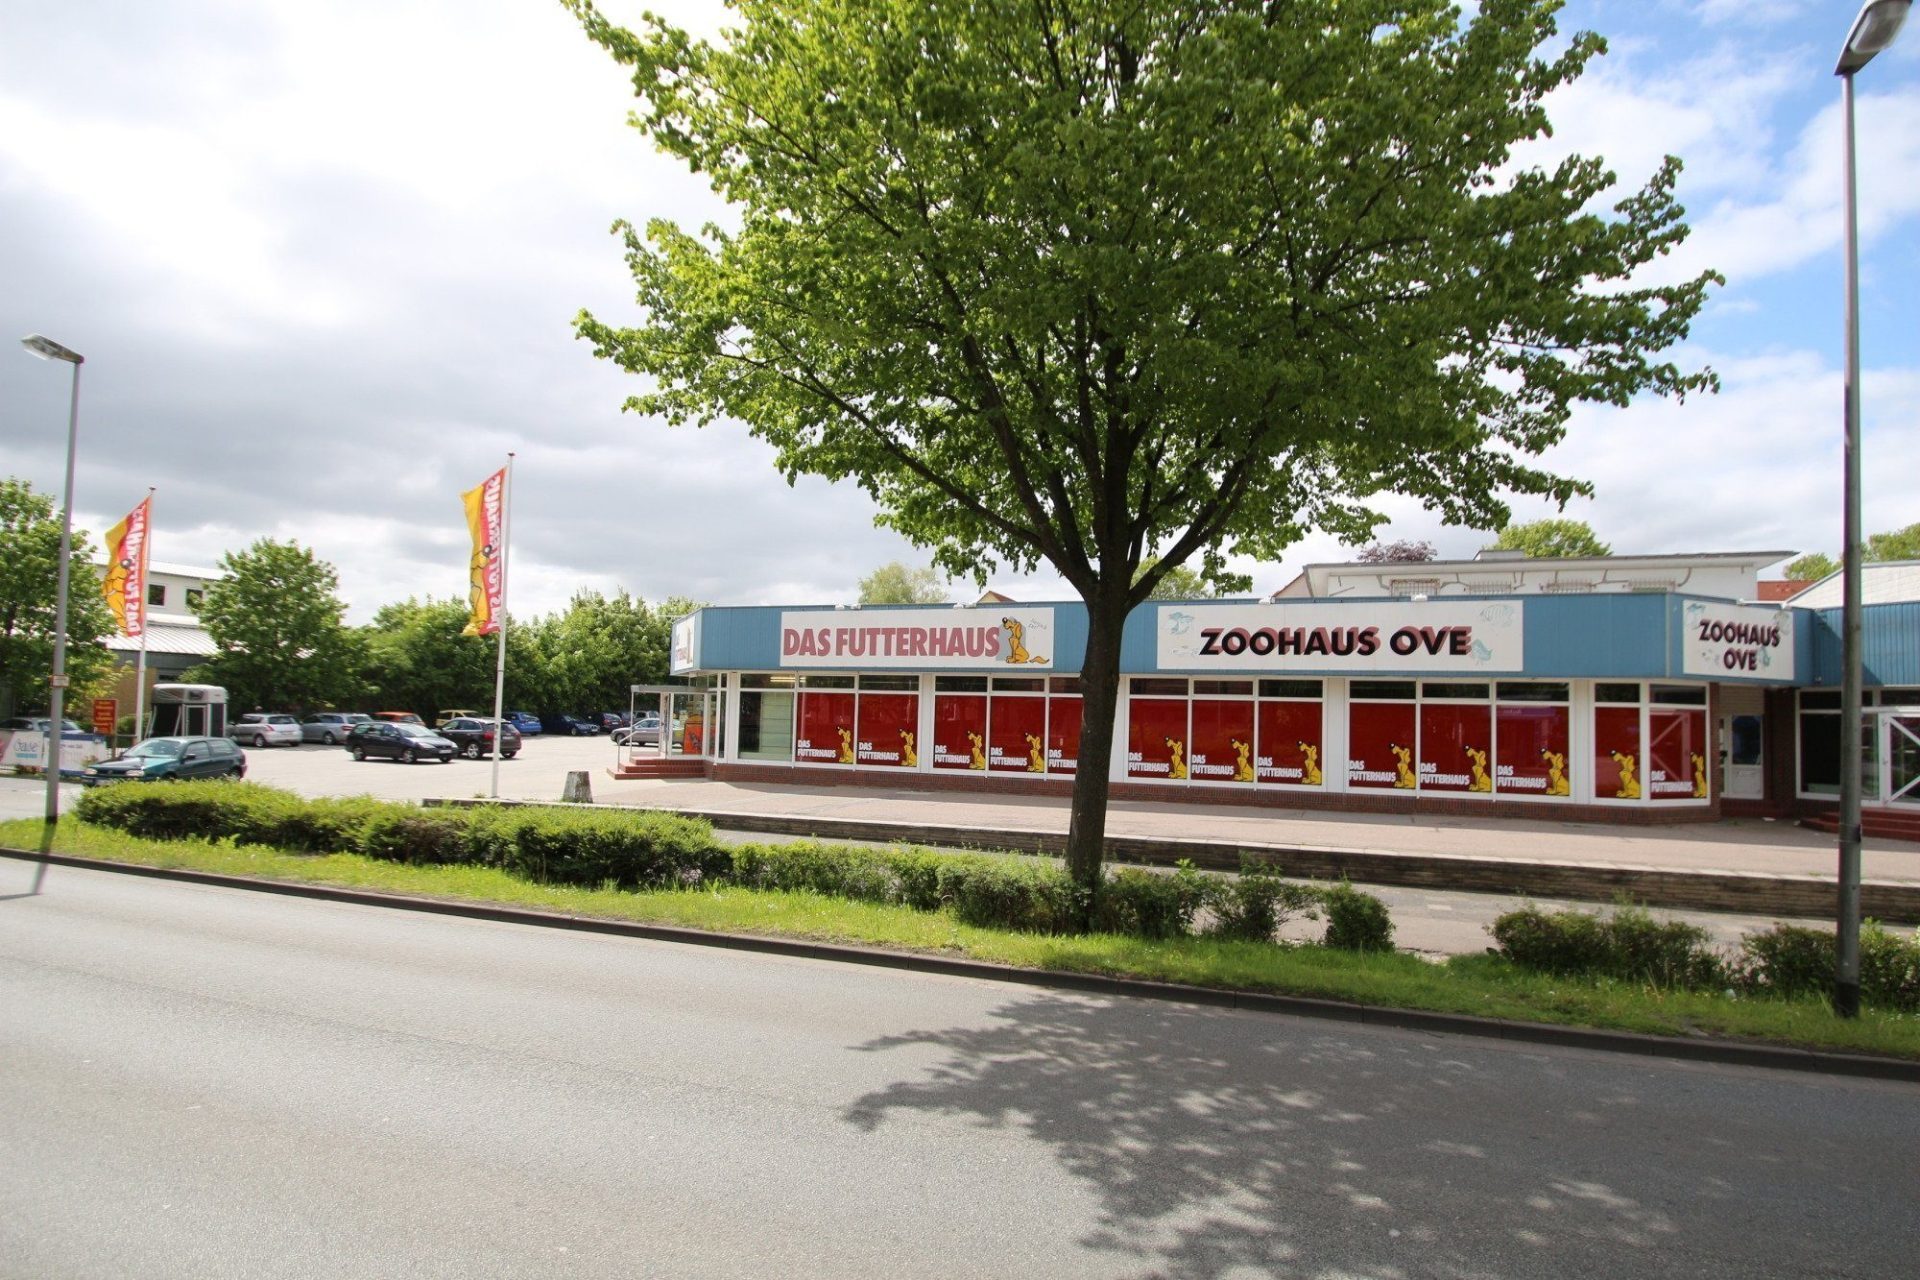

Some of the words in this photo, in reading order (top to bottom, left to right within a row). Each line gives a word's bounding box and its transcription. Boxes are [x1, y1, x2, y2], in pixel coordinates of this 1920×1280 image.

[1699, 618, 1780, 648] ZOOHAUS
[783, 628, 831, 657] DAS
[835, 626, 1000, 658] FUTTERHAUS
[1199, 626, 1381, 656] ZOOHAUS
[1389, 625, 1473, 656] OVE
[1723, 647, 1758, 671] OVE
[797, 740, 811, 748] DAS
[858, 742, 872, 751] DAS
[797, 748, 836, 758] FUTTERHAUS
[934, 745, 947, 754] DAS
[990, 747, 1003, 756] DAS
[1049, 749, 1062, 758] DAS
[858, 751, 899, 760] FUTTERHAUS
[934, 754, 970, 764] FUTTERHAUS
[1128, 752, 1142, 761] DAS
[1191, 755, 1206, 764] DAS
[990, 756, 1027, 766] FUTTERHAUS
[1258, 757, 1272, 766] DAS
[1349, 760, 1364, 770] DAS
[1128, 762, 1170, 772] FUTTERHAUS
[1191, 764, 1234, 775] FUTTERHAUS
[1420, 763, 1436, 773] DAS
[1497, 765, 1513, 776] DAS
[1258, 767, 1303, 778] FUTTERHAUS
[1349, 770, 1396, 782] FUTTERHAUS
[1420, 773, 1470, 785] FUTTERHAUS
[1497, 776, 1546, 788] FUTTERHAUS
